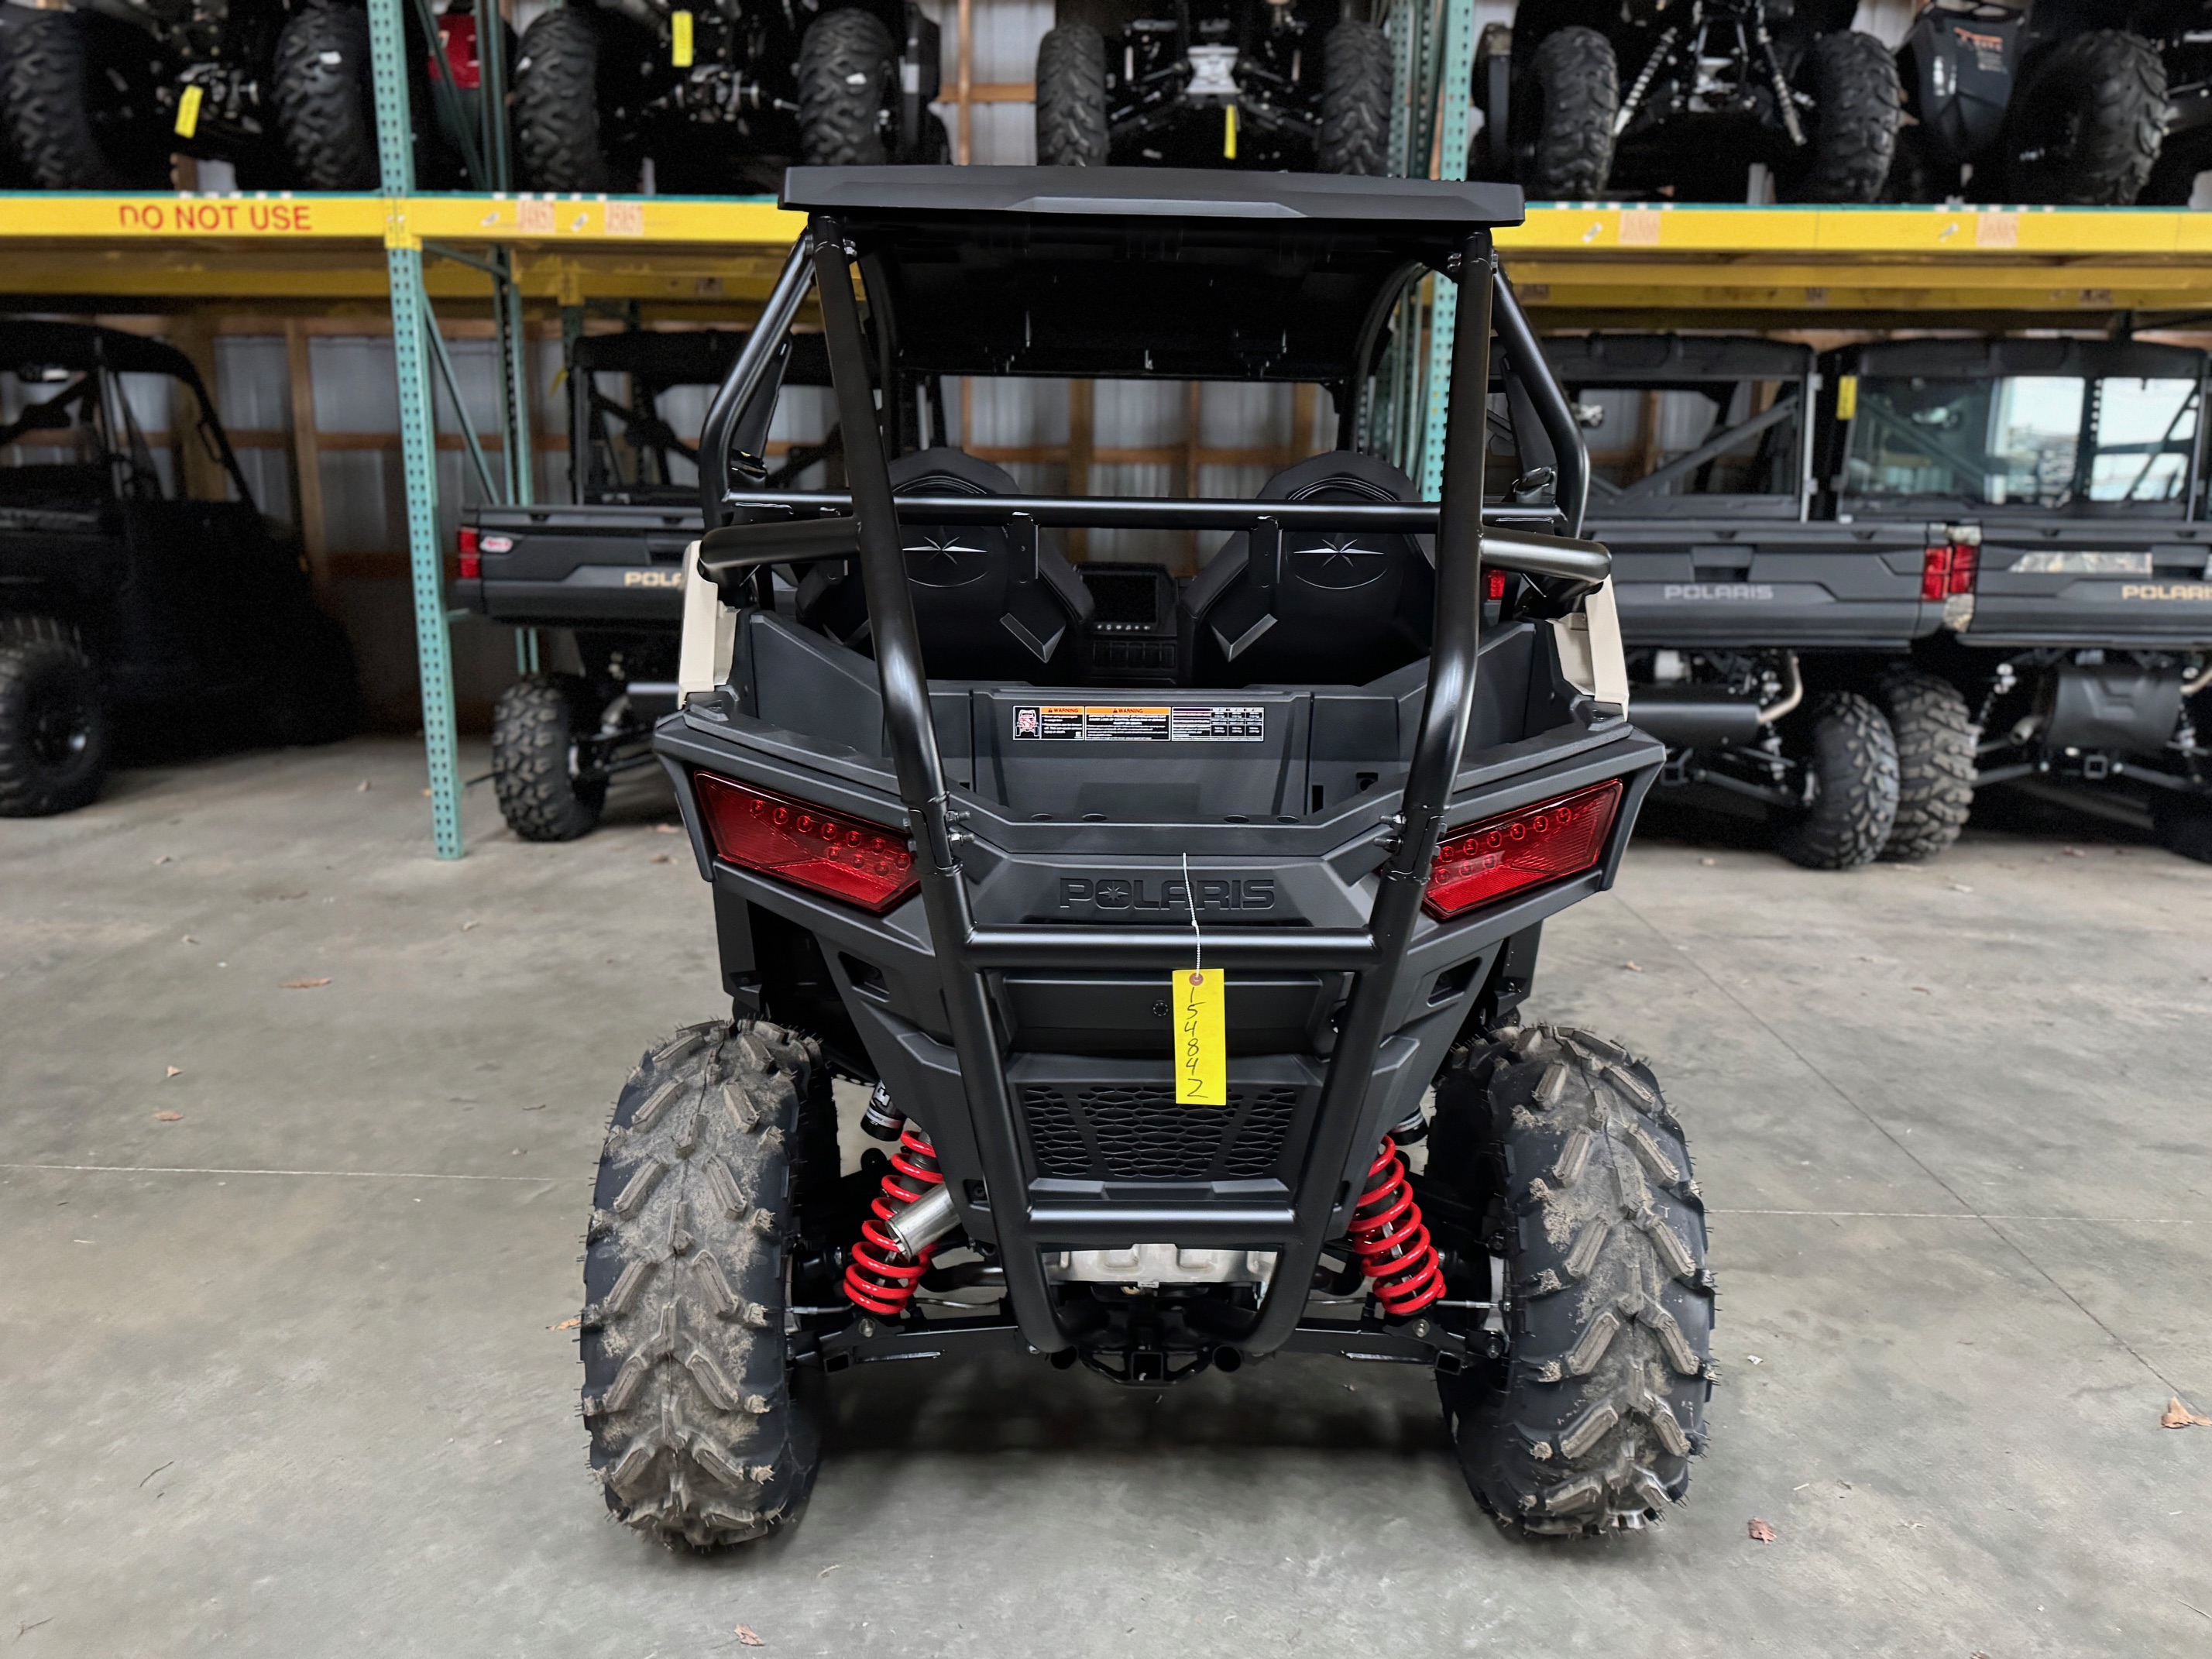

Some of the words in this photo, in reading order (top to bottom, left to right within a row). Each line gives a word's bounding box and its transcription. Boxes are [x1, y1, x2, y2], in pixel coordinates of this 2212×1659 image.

[118, 204, 164, 231] DO
[174, 204, 239, 231] NOT
[249, 204, 312, 231] USE
[1664, 584, 1774, 600] POLARIS
[2122, 584, 2212, 600] POLARI
[1060, 878, 1276, 910] POLARIS
